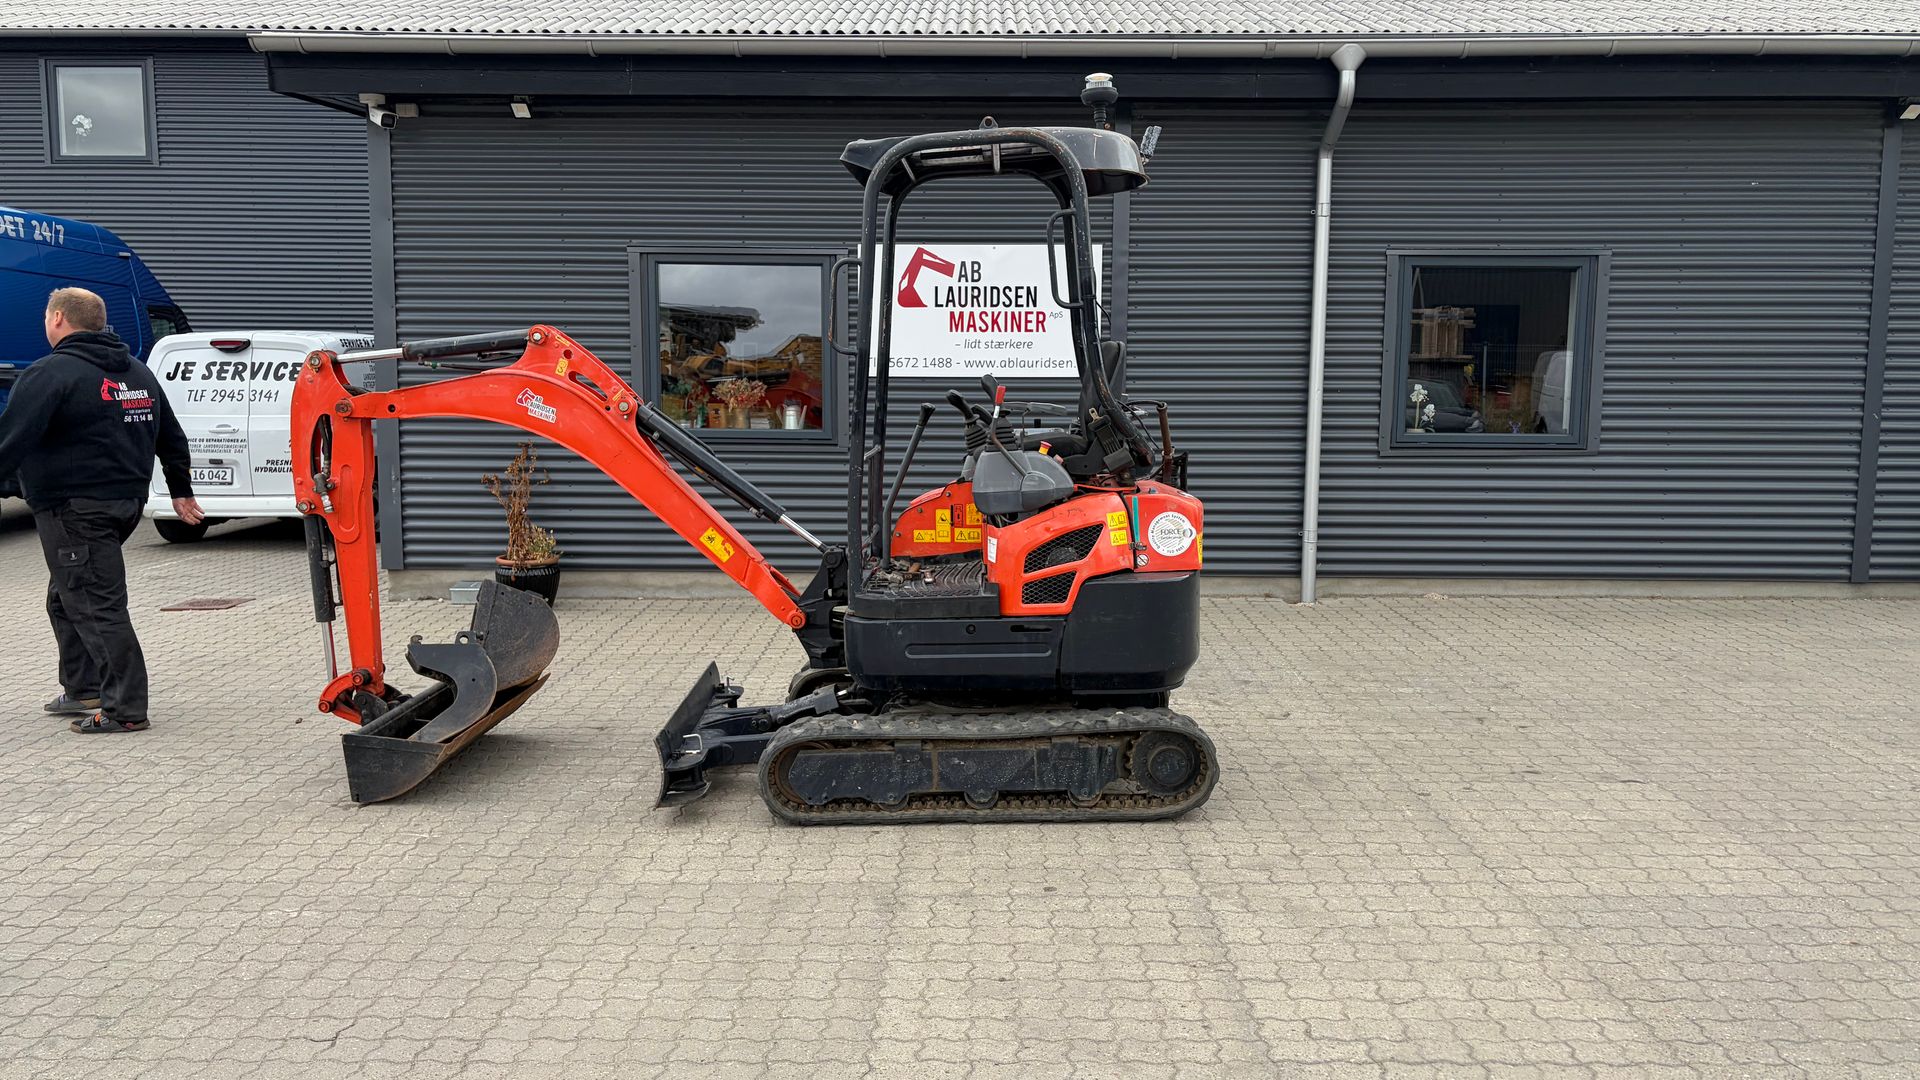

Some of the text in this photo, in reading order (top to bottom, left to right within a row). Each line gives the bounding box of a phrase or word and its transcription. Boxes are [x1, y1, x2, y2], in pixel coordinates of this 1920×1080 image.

[31, 220, 64, 246] 24/7
[957, 260, 982, 283] AB
[934, 286, 1038, 308] LAURIDSEN
[949, 311, 1064, 333] MASKINER ApS
[964, 339, 982, 350] lidt
[984, 339, 1034, 350] stærkere
[889, 357, 919, 368] 5672
[922, 357, 953, 368] 1488
[166, 361, 304, 382] JE SERVICE
[118, 382, 128, 391] AB
[114, 389, 149, 400] LAURIDSEN
[187, 389, 279, 403] TLF 2945 3141
[121, 398, 153, 409] MASKINER
[525, 400, 556, 415] LAURIDSEN
[193, 469, 228, 480] 16 042
[1160, 528, 1181, 536] FORCE
